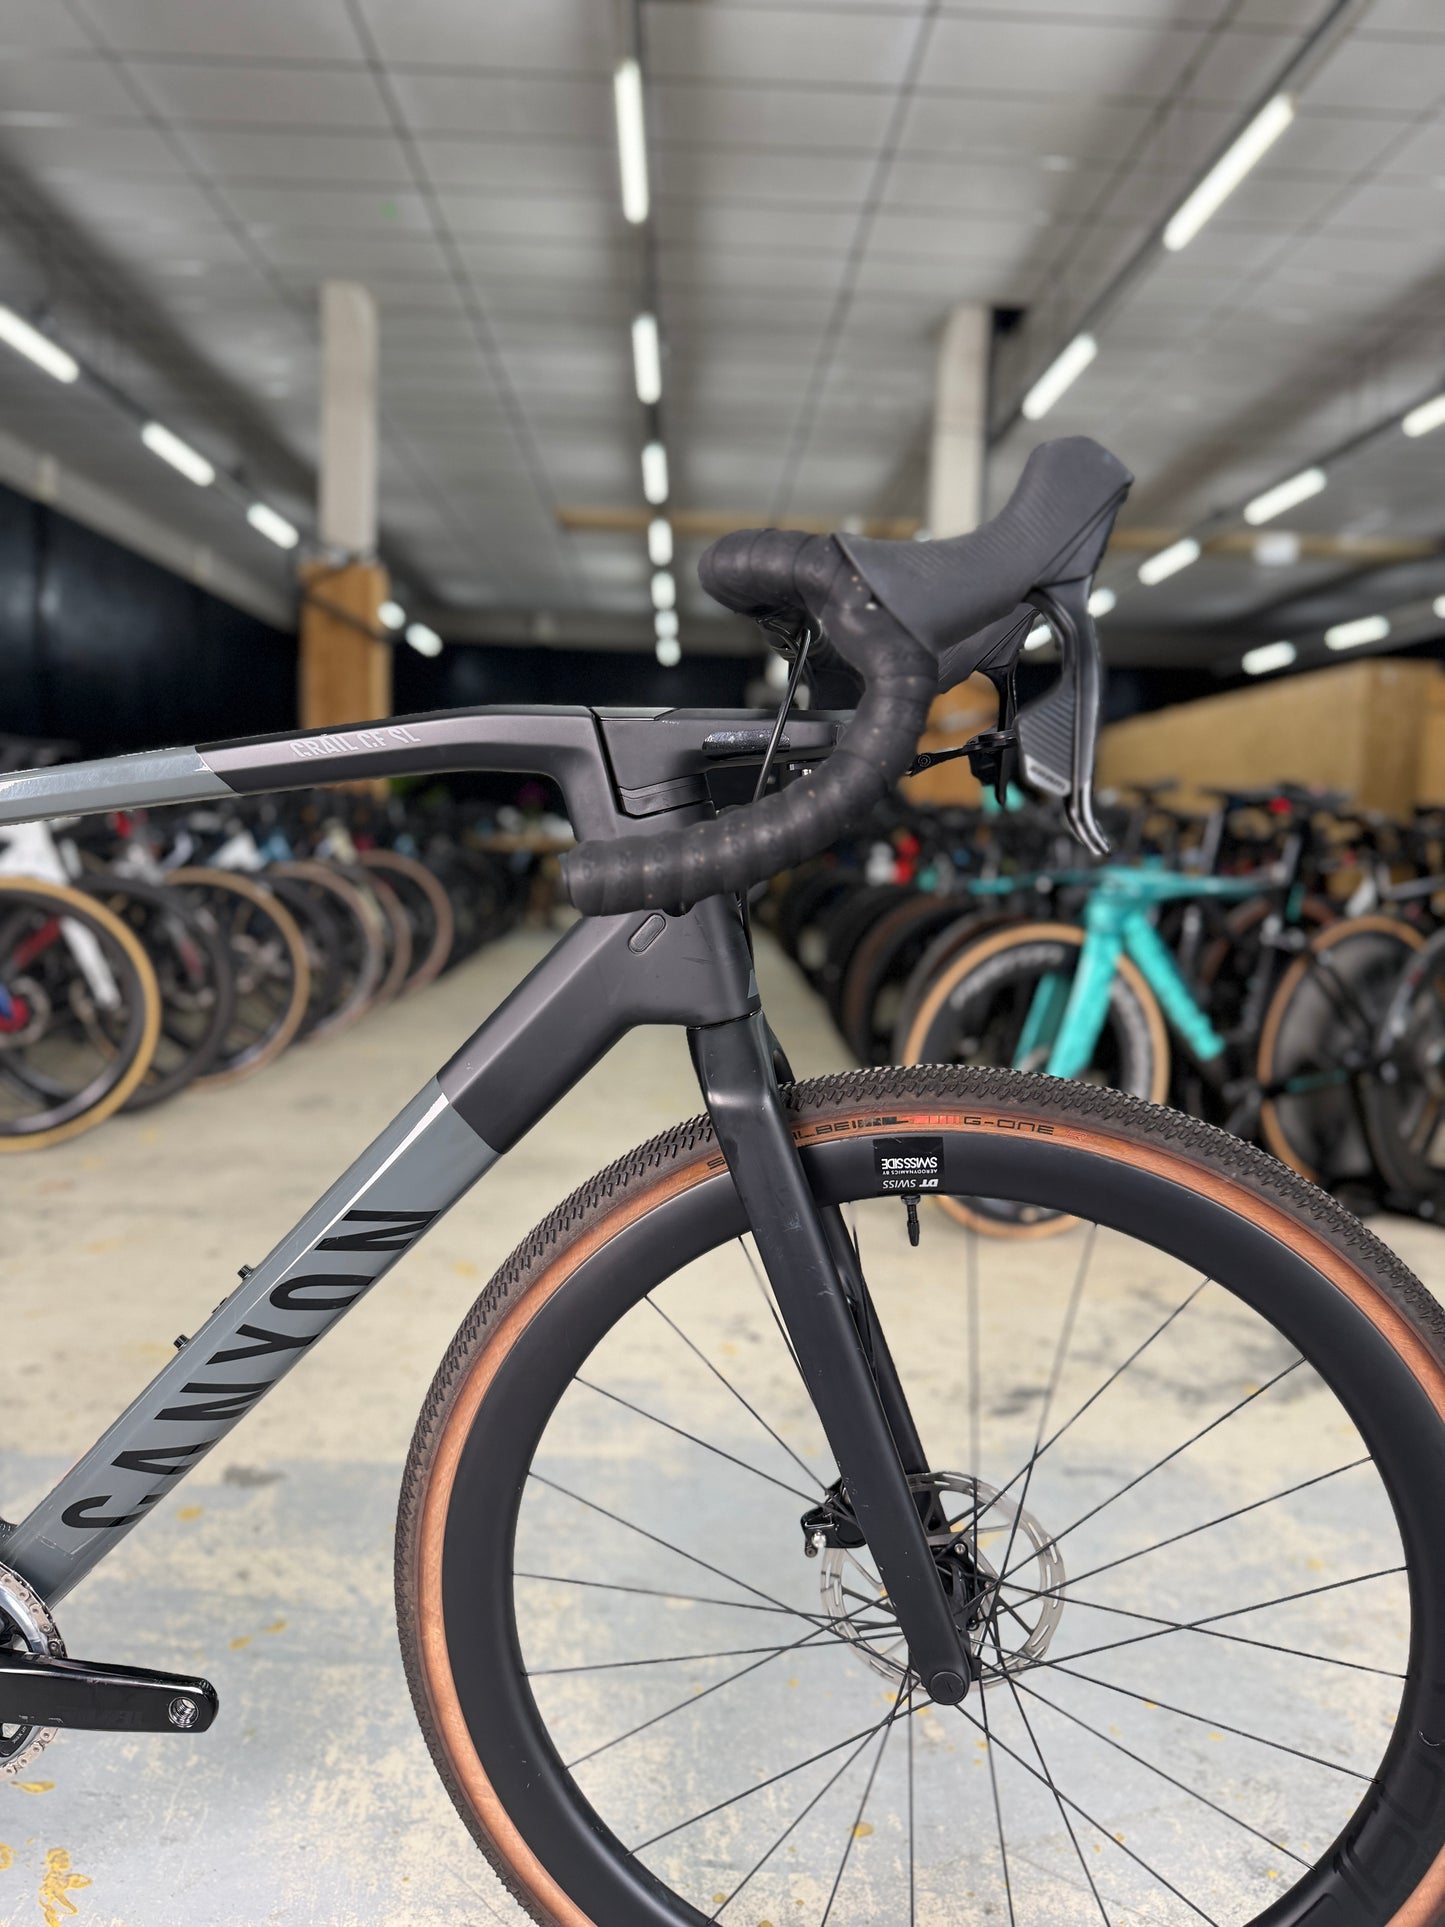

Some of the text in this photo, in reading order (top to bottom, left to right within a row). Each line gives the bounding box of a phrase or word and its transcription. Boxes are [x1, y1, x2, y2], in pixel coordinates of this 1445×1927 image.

[289, 727, 421, 758] GRAIL CF SL
[963, 1116, 1055, 1136] G-ONE
[882, 1178, 939, 1189] DT SWISS
[61, 1208, 442, 1529] CANYON
